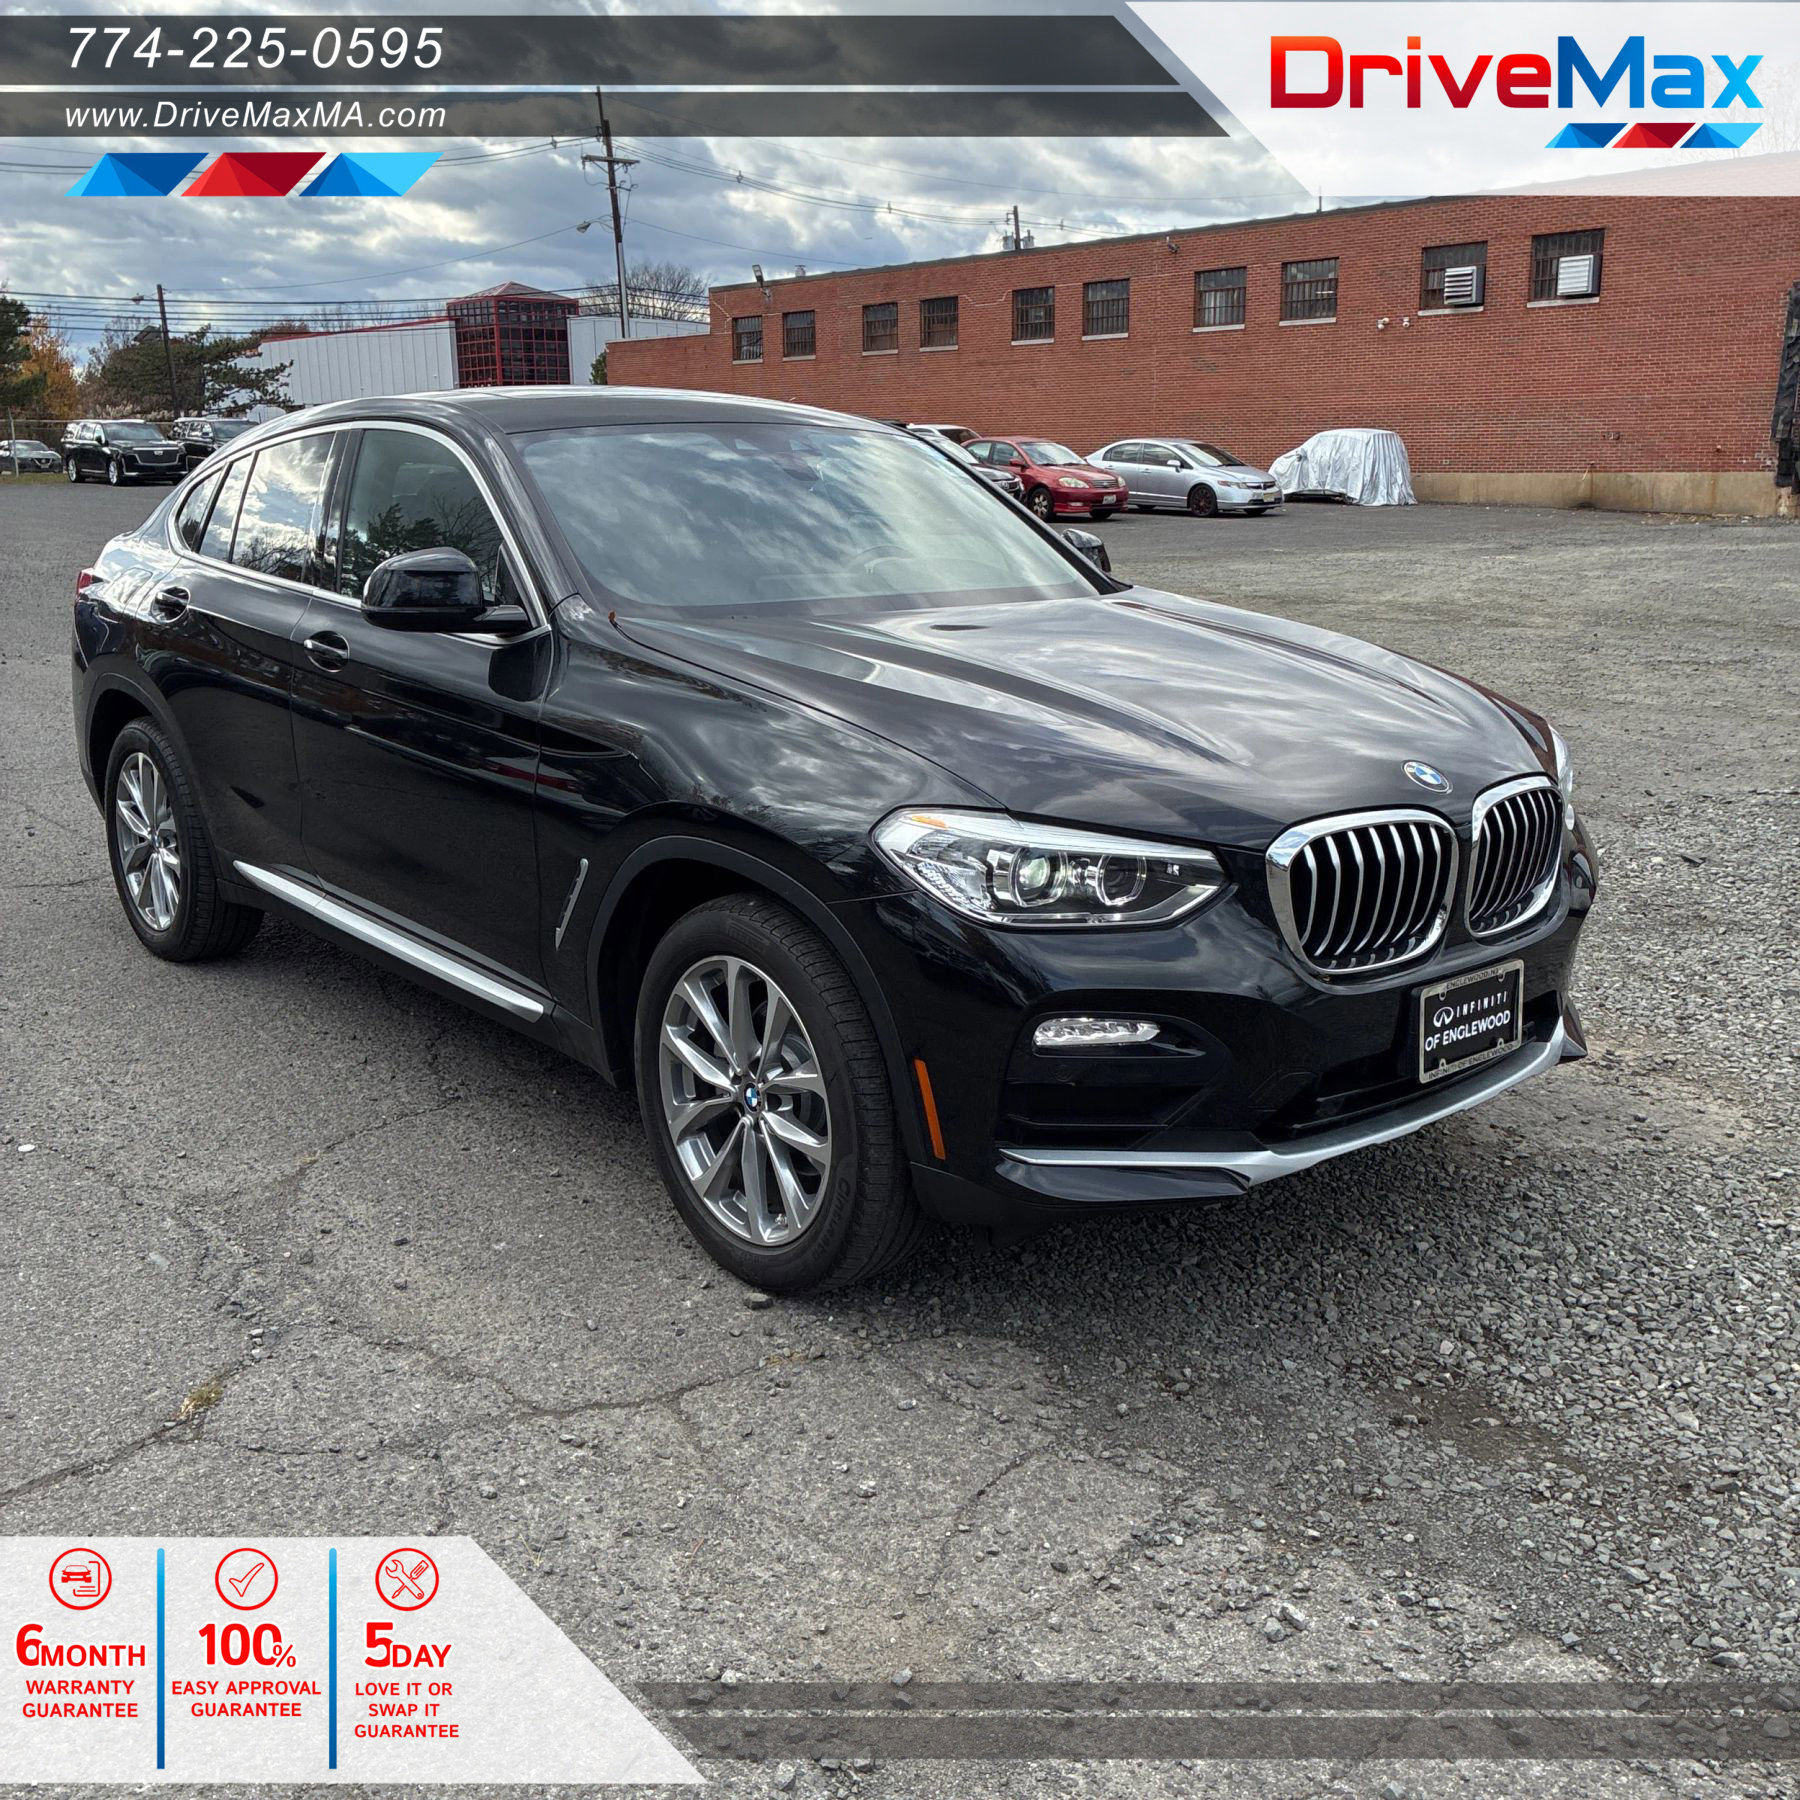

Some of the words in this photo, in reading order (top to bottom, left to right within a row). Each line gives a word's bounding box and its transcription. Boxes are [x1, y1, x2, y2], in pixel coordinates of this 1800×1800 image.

[1456, 991, 1508, 1018] INFINITI
[1424, 1033, 1441, 1052] OF
[1442, 1010, 1511, 1045] ENGLEWOOD
